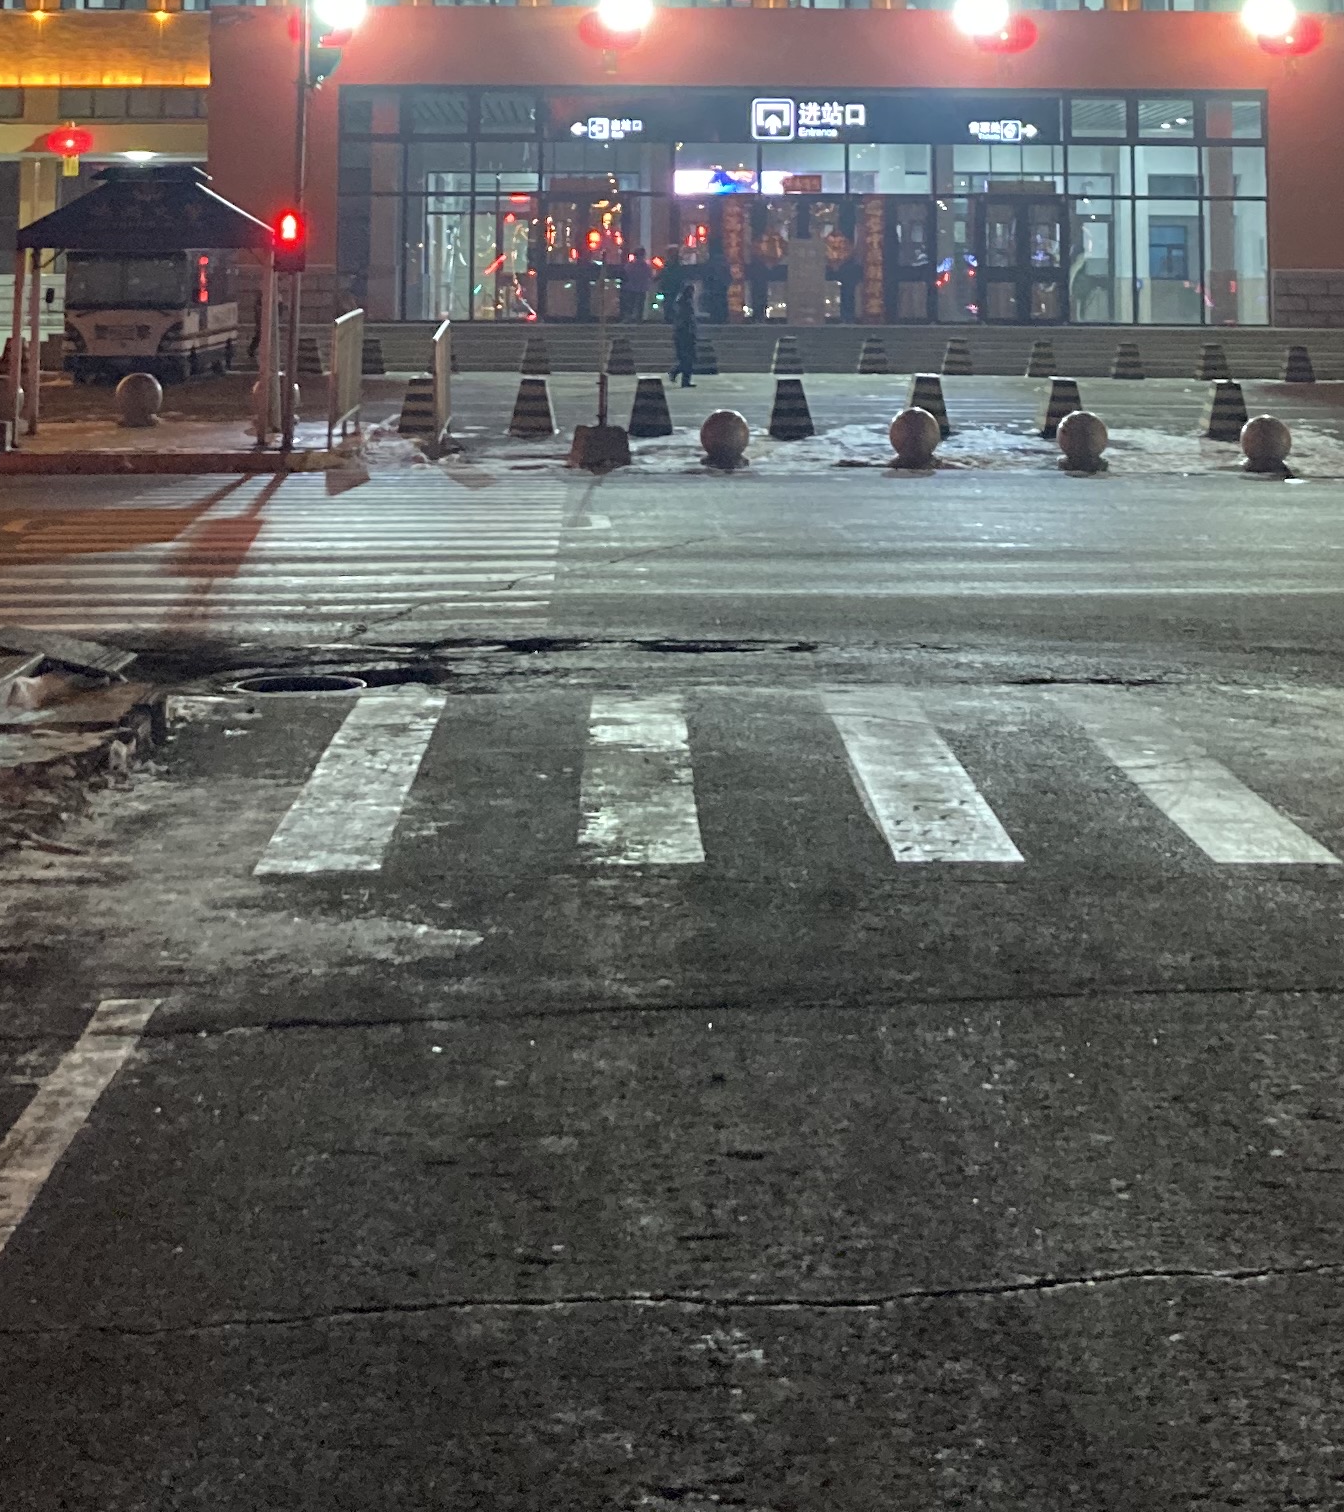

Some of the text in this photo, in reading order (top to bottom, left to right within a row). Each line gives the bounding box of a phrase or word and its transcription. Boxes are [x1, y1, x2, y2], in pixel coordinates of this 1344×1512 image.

[798, 101, 865, 125] 进站口
[798, 126, 838, 137] Entrance
